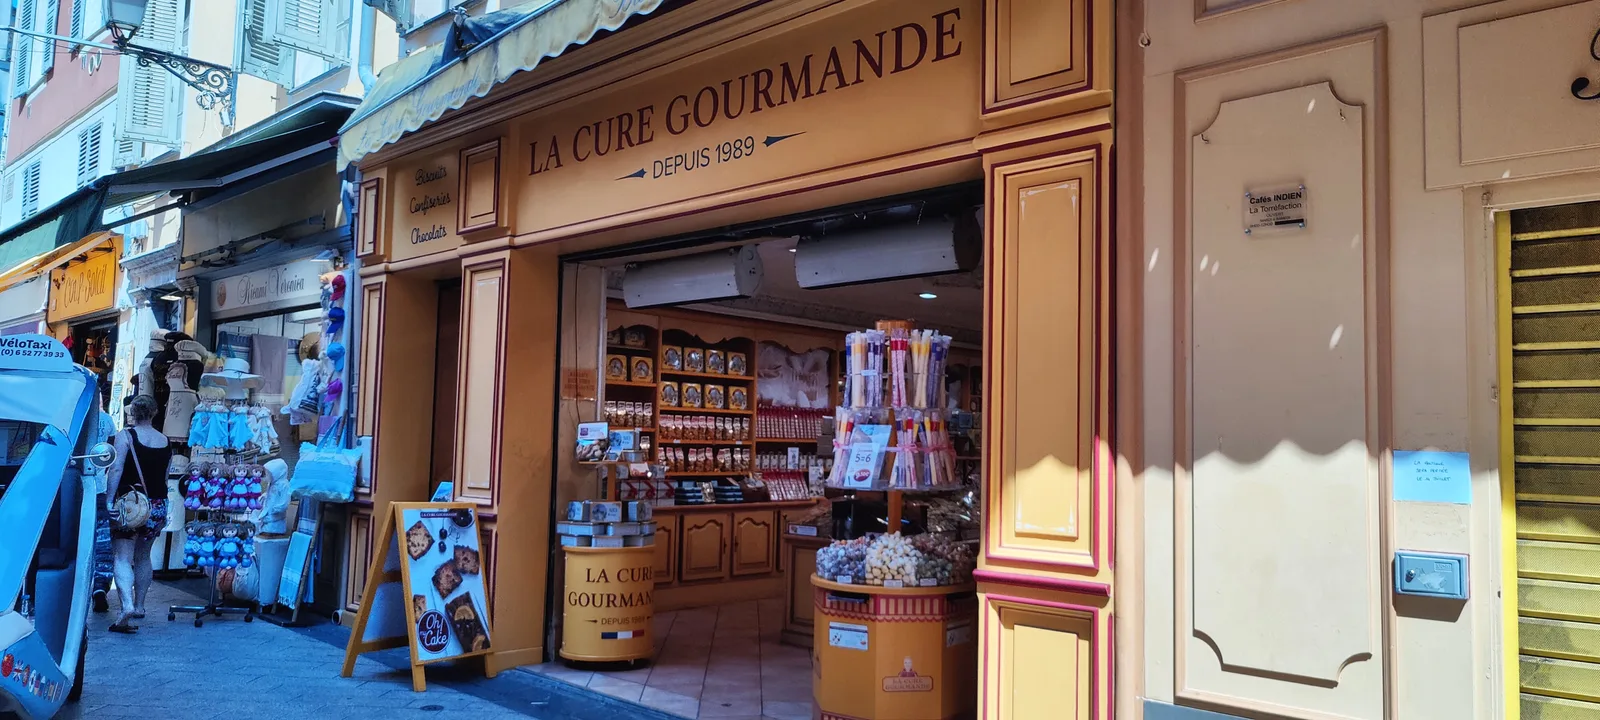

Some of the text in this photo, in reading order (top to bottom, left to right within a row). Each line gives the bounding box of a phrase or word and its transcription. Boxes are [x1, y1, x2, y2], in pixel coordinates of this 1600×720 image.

[529, 7, 963, 176] LA CURE GOURMANDE
[652, 135, 755, 180] DEPUIS 1989
[415, 165, 447, 186] Biscuits
[410, 192, 451, 215] Confiseries
[1250, 192, 1302, 204] Cafés INDIEN
[1260, 203, 1302, 212] Torréfaction
[411, 225, 447, 244] Chocolats
[0, 337, 52, 350] VéloTaxi
[1, 348, 14, 356] (0)
[22, 349, 32, 357] 52
[586, 568, 610, 583] LA
[426, 614, 444, 635] Oh!
[601, 617, 630, 625] DEPUIS
[424, 628, 448, 646] Cake
